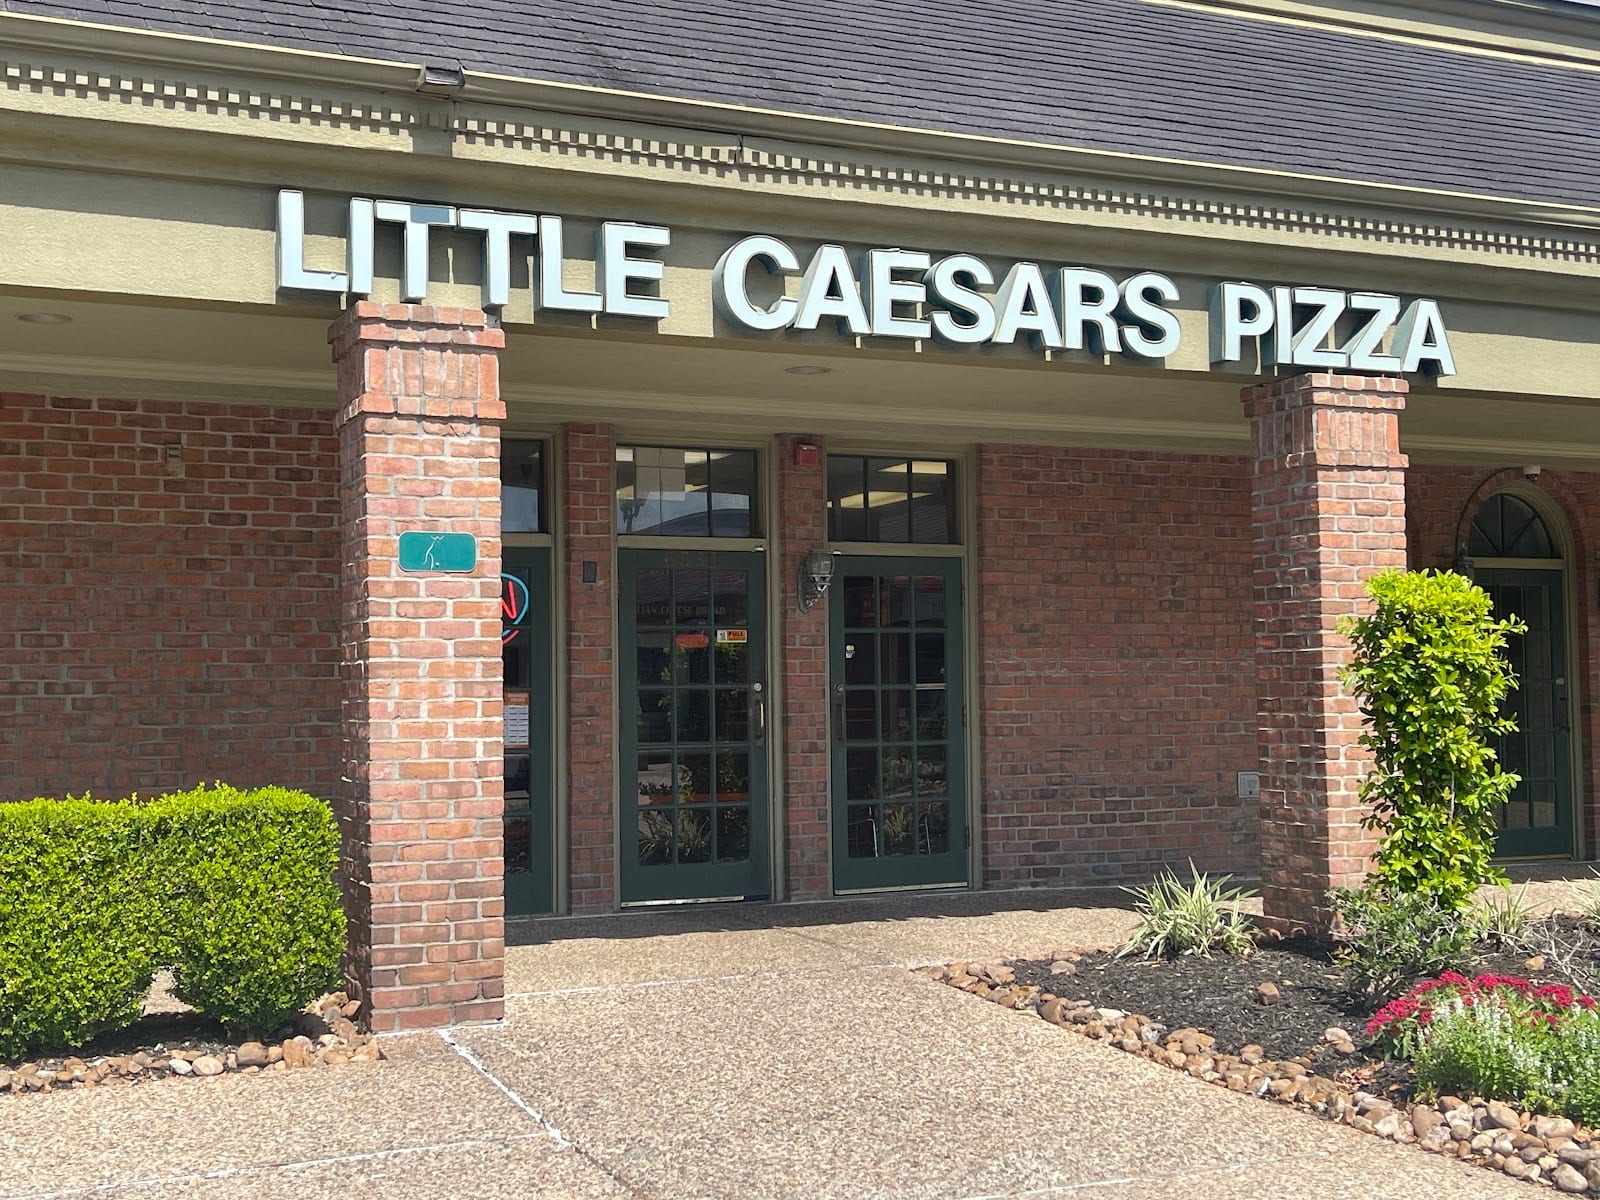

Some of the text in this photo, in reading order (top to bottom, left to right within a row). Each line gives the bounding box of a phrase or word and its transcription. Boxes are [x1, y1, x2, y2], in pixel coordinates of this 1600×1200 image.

[277, 189, 1456, 376] LITTLE CAESARS PIZZA
